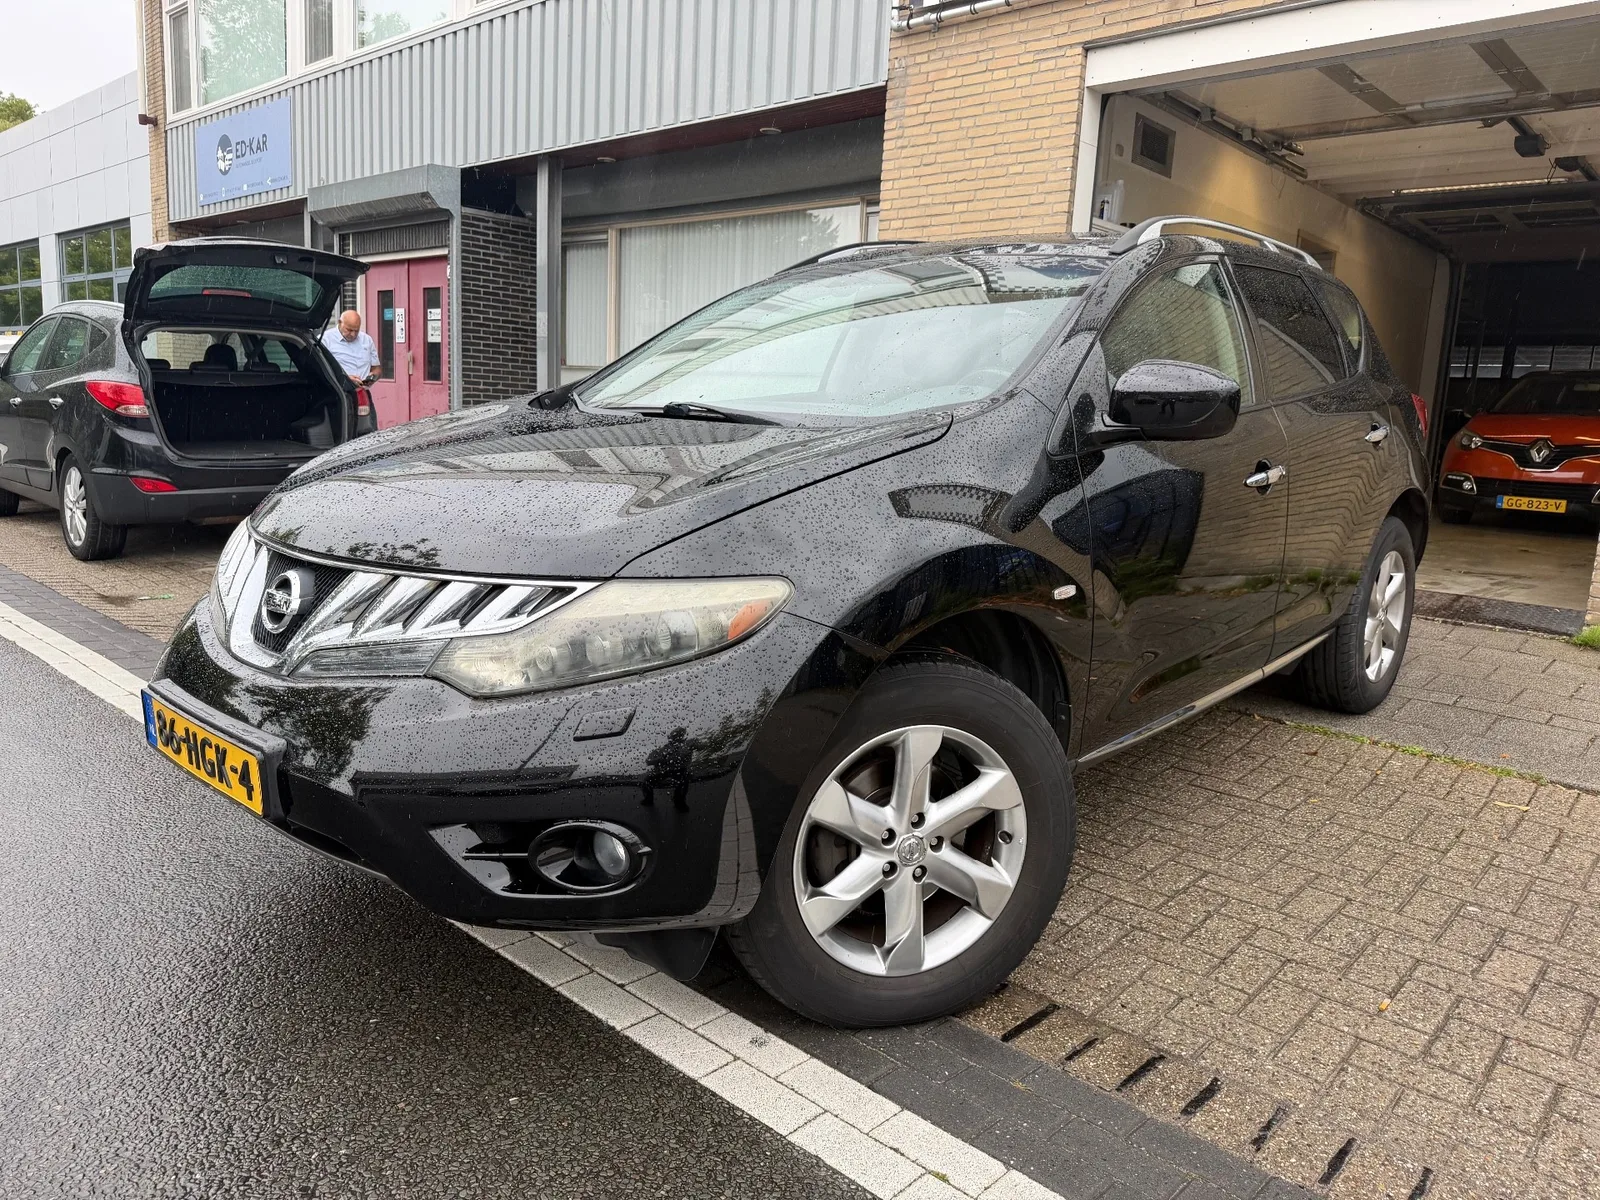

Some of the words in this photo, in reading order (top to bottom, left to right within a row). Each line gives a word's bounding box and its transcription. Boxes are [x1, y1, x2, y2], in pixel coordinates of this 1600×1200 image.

[235, 133, 268, 159] ED-KAR
[1506, 498, 1562, 511] GG-823-V
[156, 708, 255, 803] 86-HGK-4
